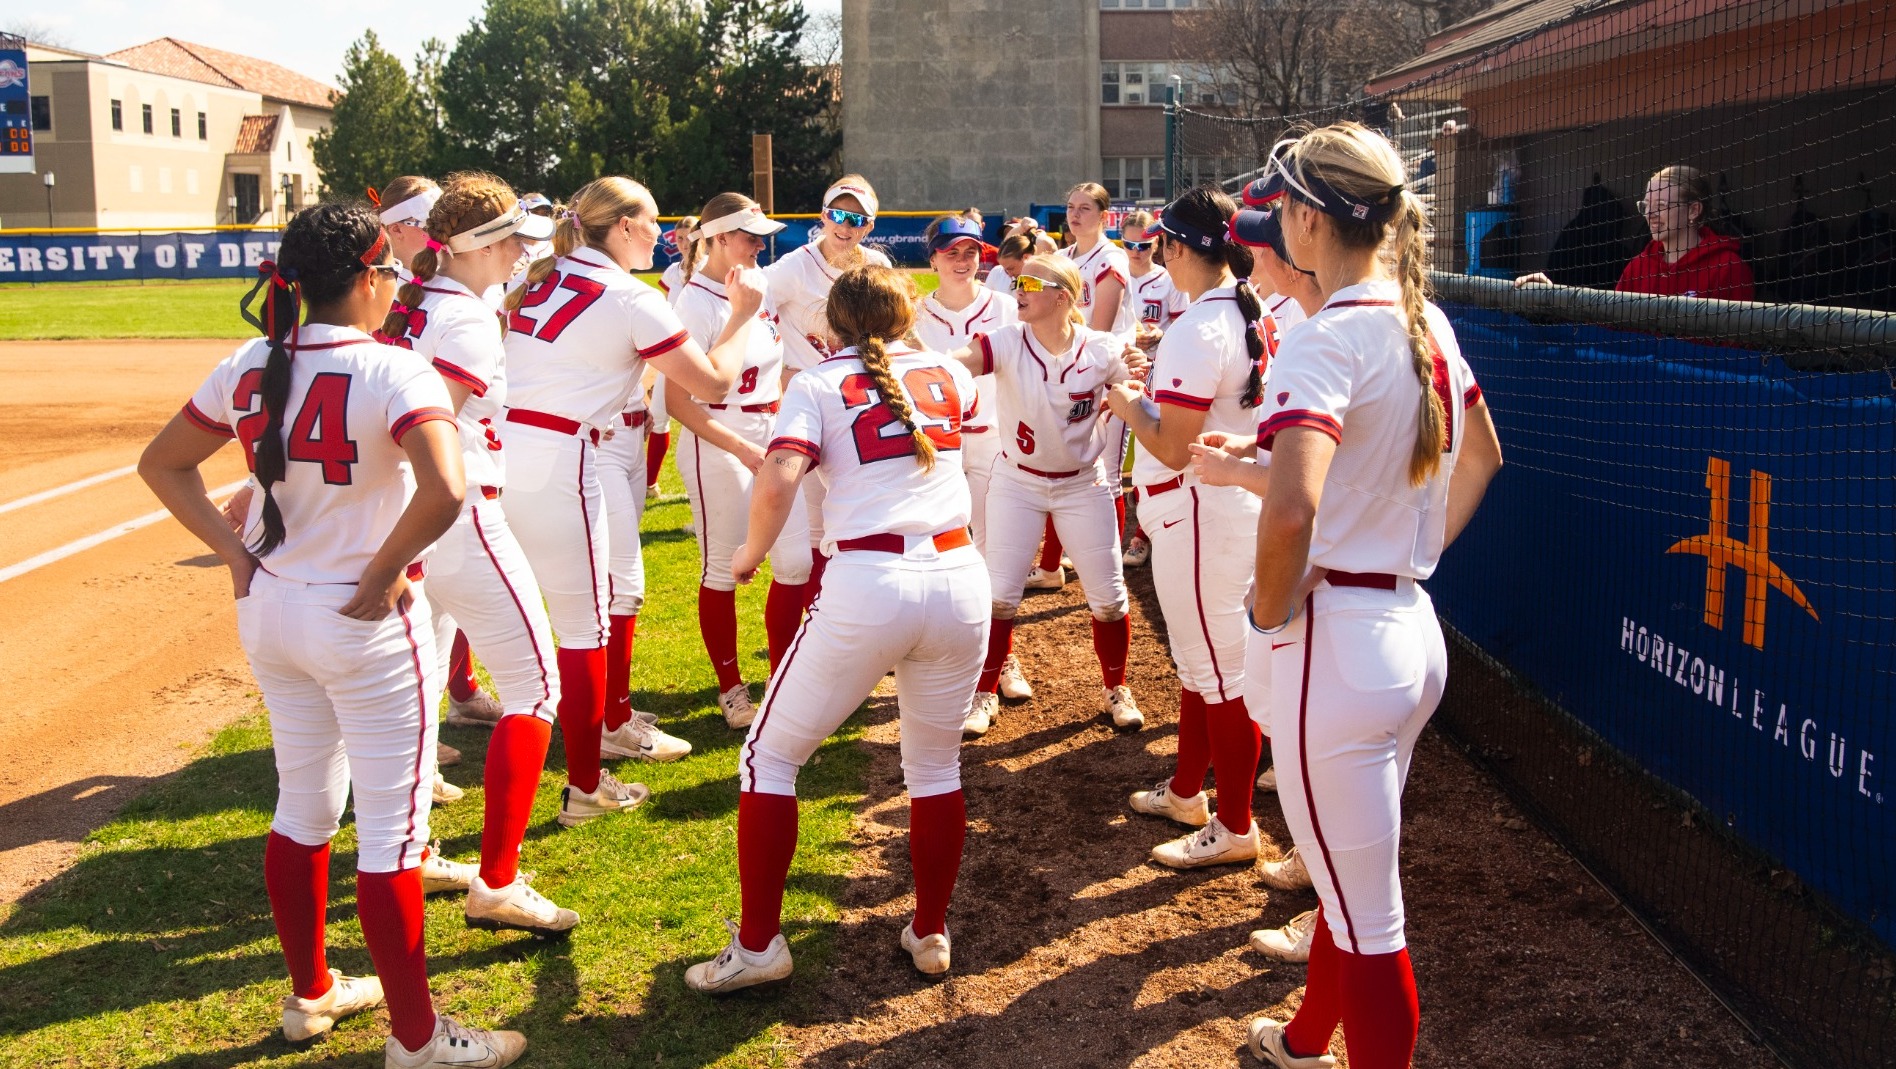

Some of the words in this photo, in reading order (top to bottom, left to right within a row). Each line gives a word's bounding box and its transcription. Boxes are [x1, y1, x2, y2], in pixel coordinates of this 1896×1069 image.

[155, 243, 205, 269] OF
[497, 269, 607, 343] 27
[233, 367, 359, 485] 24
[839, 365, 962, 465] 29
[1016, 421, 1035, 455] 5
[1620, 616, 1725, 707] HORIZON
[1731, 677, 1875, 798] LEAGUE
